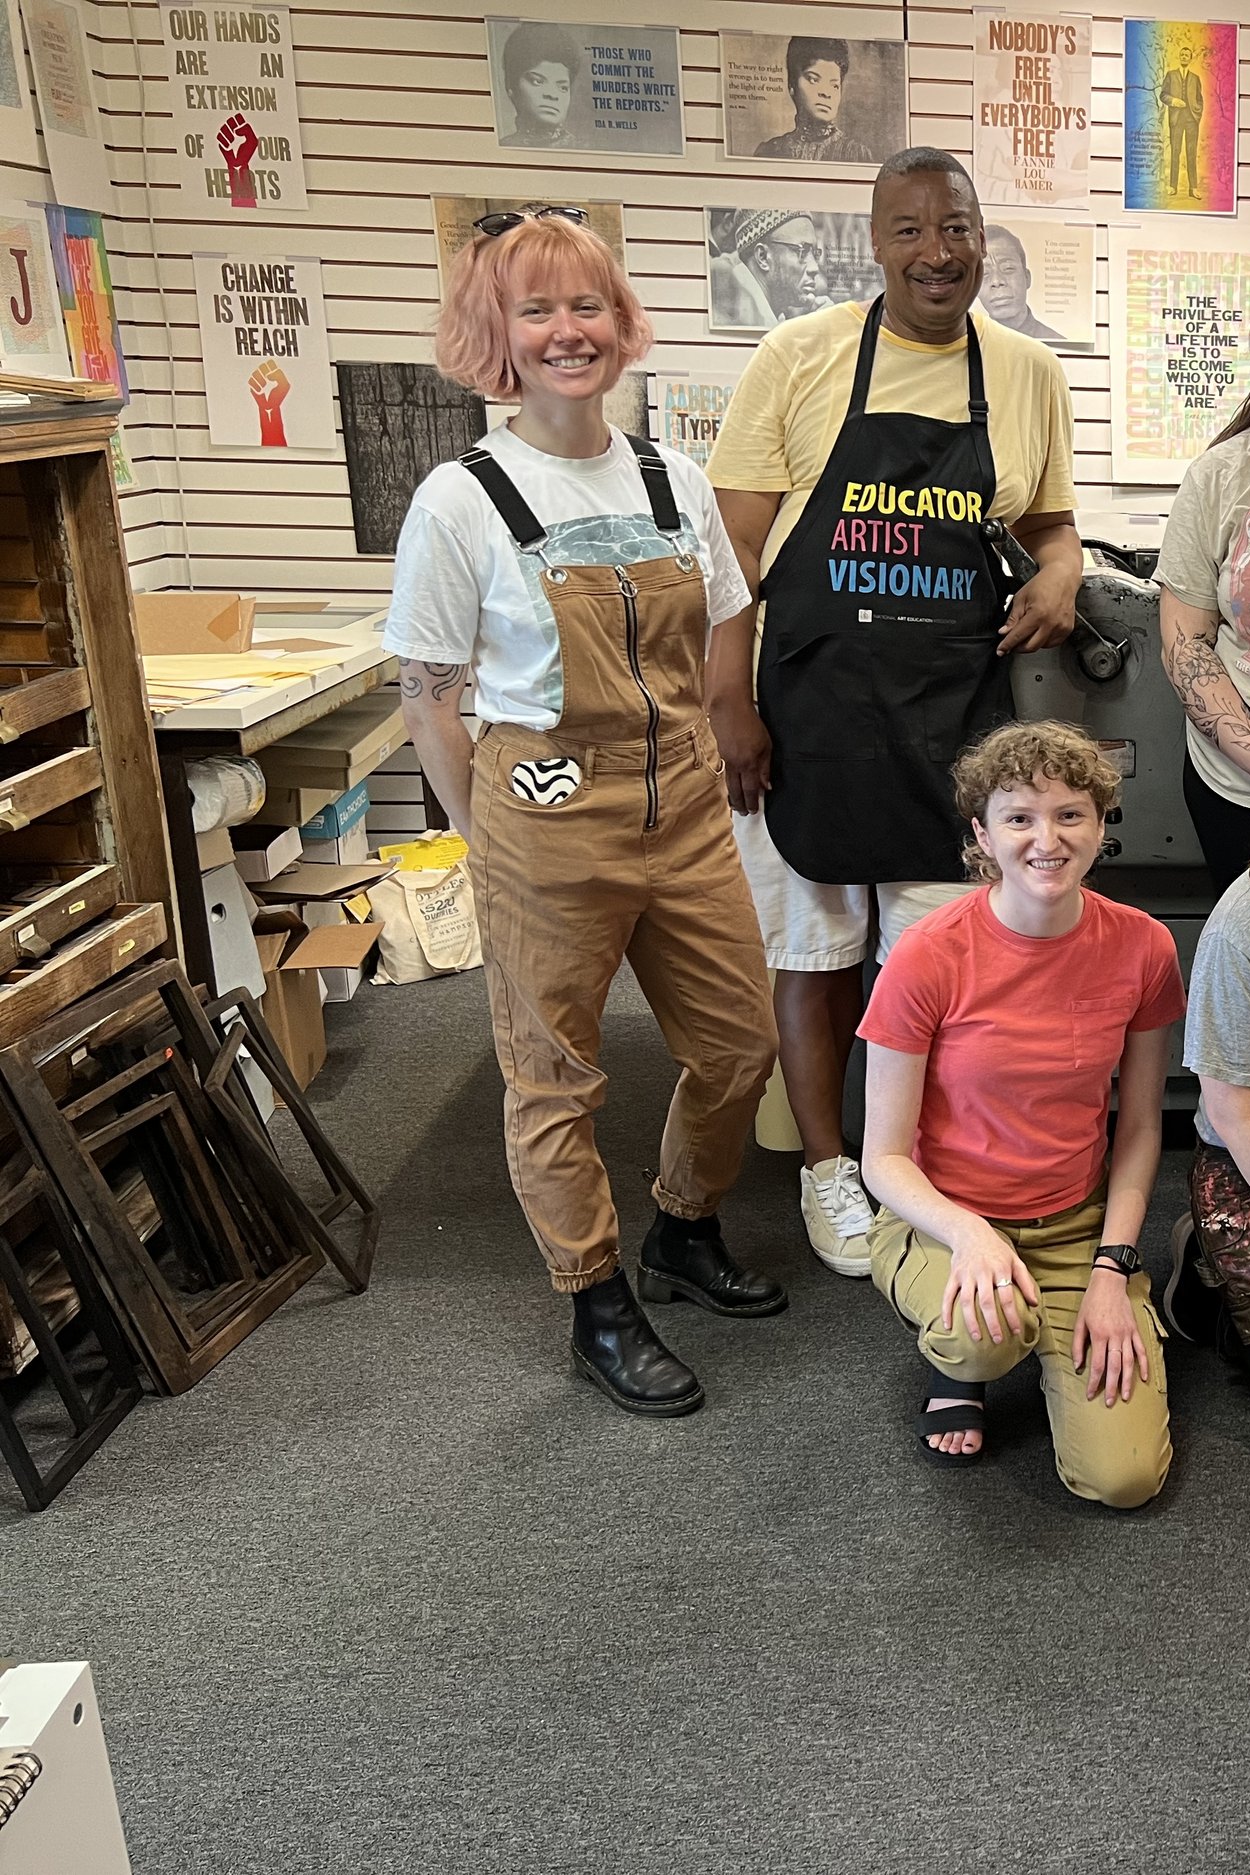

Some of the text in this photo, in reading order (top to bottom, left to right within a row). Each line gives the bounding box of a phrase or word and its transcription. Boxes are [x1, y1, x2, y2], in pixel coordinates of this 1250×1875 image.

[169, 10, 281, 44] OUR HANDS
[989, 20, 1076, 55] NOBODY'S
[628, 48, 652, 61] WHO
[176, 50, 284, 78] ARE AN
[591, 63, 655, 78] COMMIT THE
[728, 61, 741, 69] The
[767, 65, 783, 73] right
[1015, 56, 1051, 81] FREE
[592, 80, 676, 96] MURDERS WRITE
[741, 83, 756, 91] light
[1012, 80, 1055, 106] UNTIL
[185, 84, 277, 111] EXTENSION
[592, 97, 612, 109] THE
[981, 103, 1087, 130] EVERYBODY'S
[615, 121, 638, 129] WELLS
[184, 134, 292, 161] OF OUR
[1012, 128, 1055, 158] FREE
[1013, 156, 1055, 168] FANNIE
[1024, 168, 1046, 179] LOU
[204, 168, 281, 199] HEARTS
[1015, 179, 1053, 191] HAMER
[221, 263, 297, 294] CHANGE
[10, 248, 33, 326] J
[1186, 296, 1217, 308] THE
[213, 294, 309, 326] IS WITHIN
[1162, 308, 1243, 322] PRIVILEGE
[1186, 323, 1219, 333] OF A
[235, 327, 299, 357] REACH
[1165, 335, 1238, 347] LIFETIME
[1183, 348, 1221, 358] IS TO
[1167, 360, 1233, 372] BECOME
[1166, 372, 1235, 385] WHO YOU
[1175, 385, 1226, 397] TRULY
[1184, 398, 1218, 409] ARE.
[842, 481, 982, 523] EDUCATOR
[831, 519, 924, 557] ARTIST
[828, 559, 977, 600] VISIONARY
[907, 615, 934, 623] EDUCATION
[1235, 659, 1250, 675] THE
